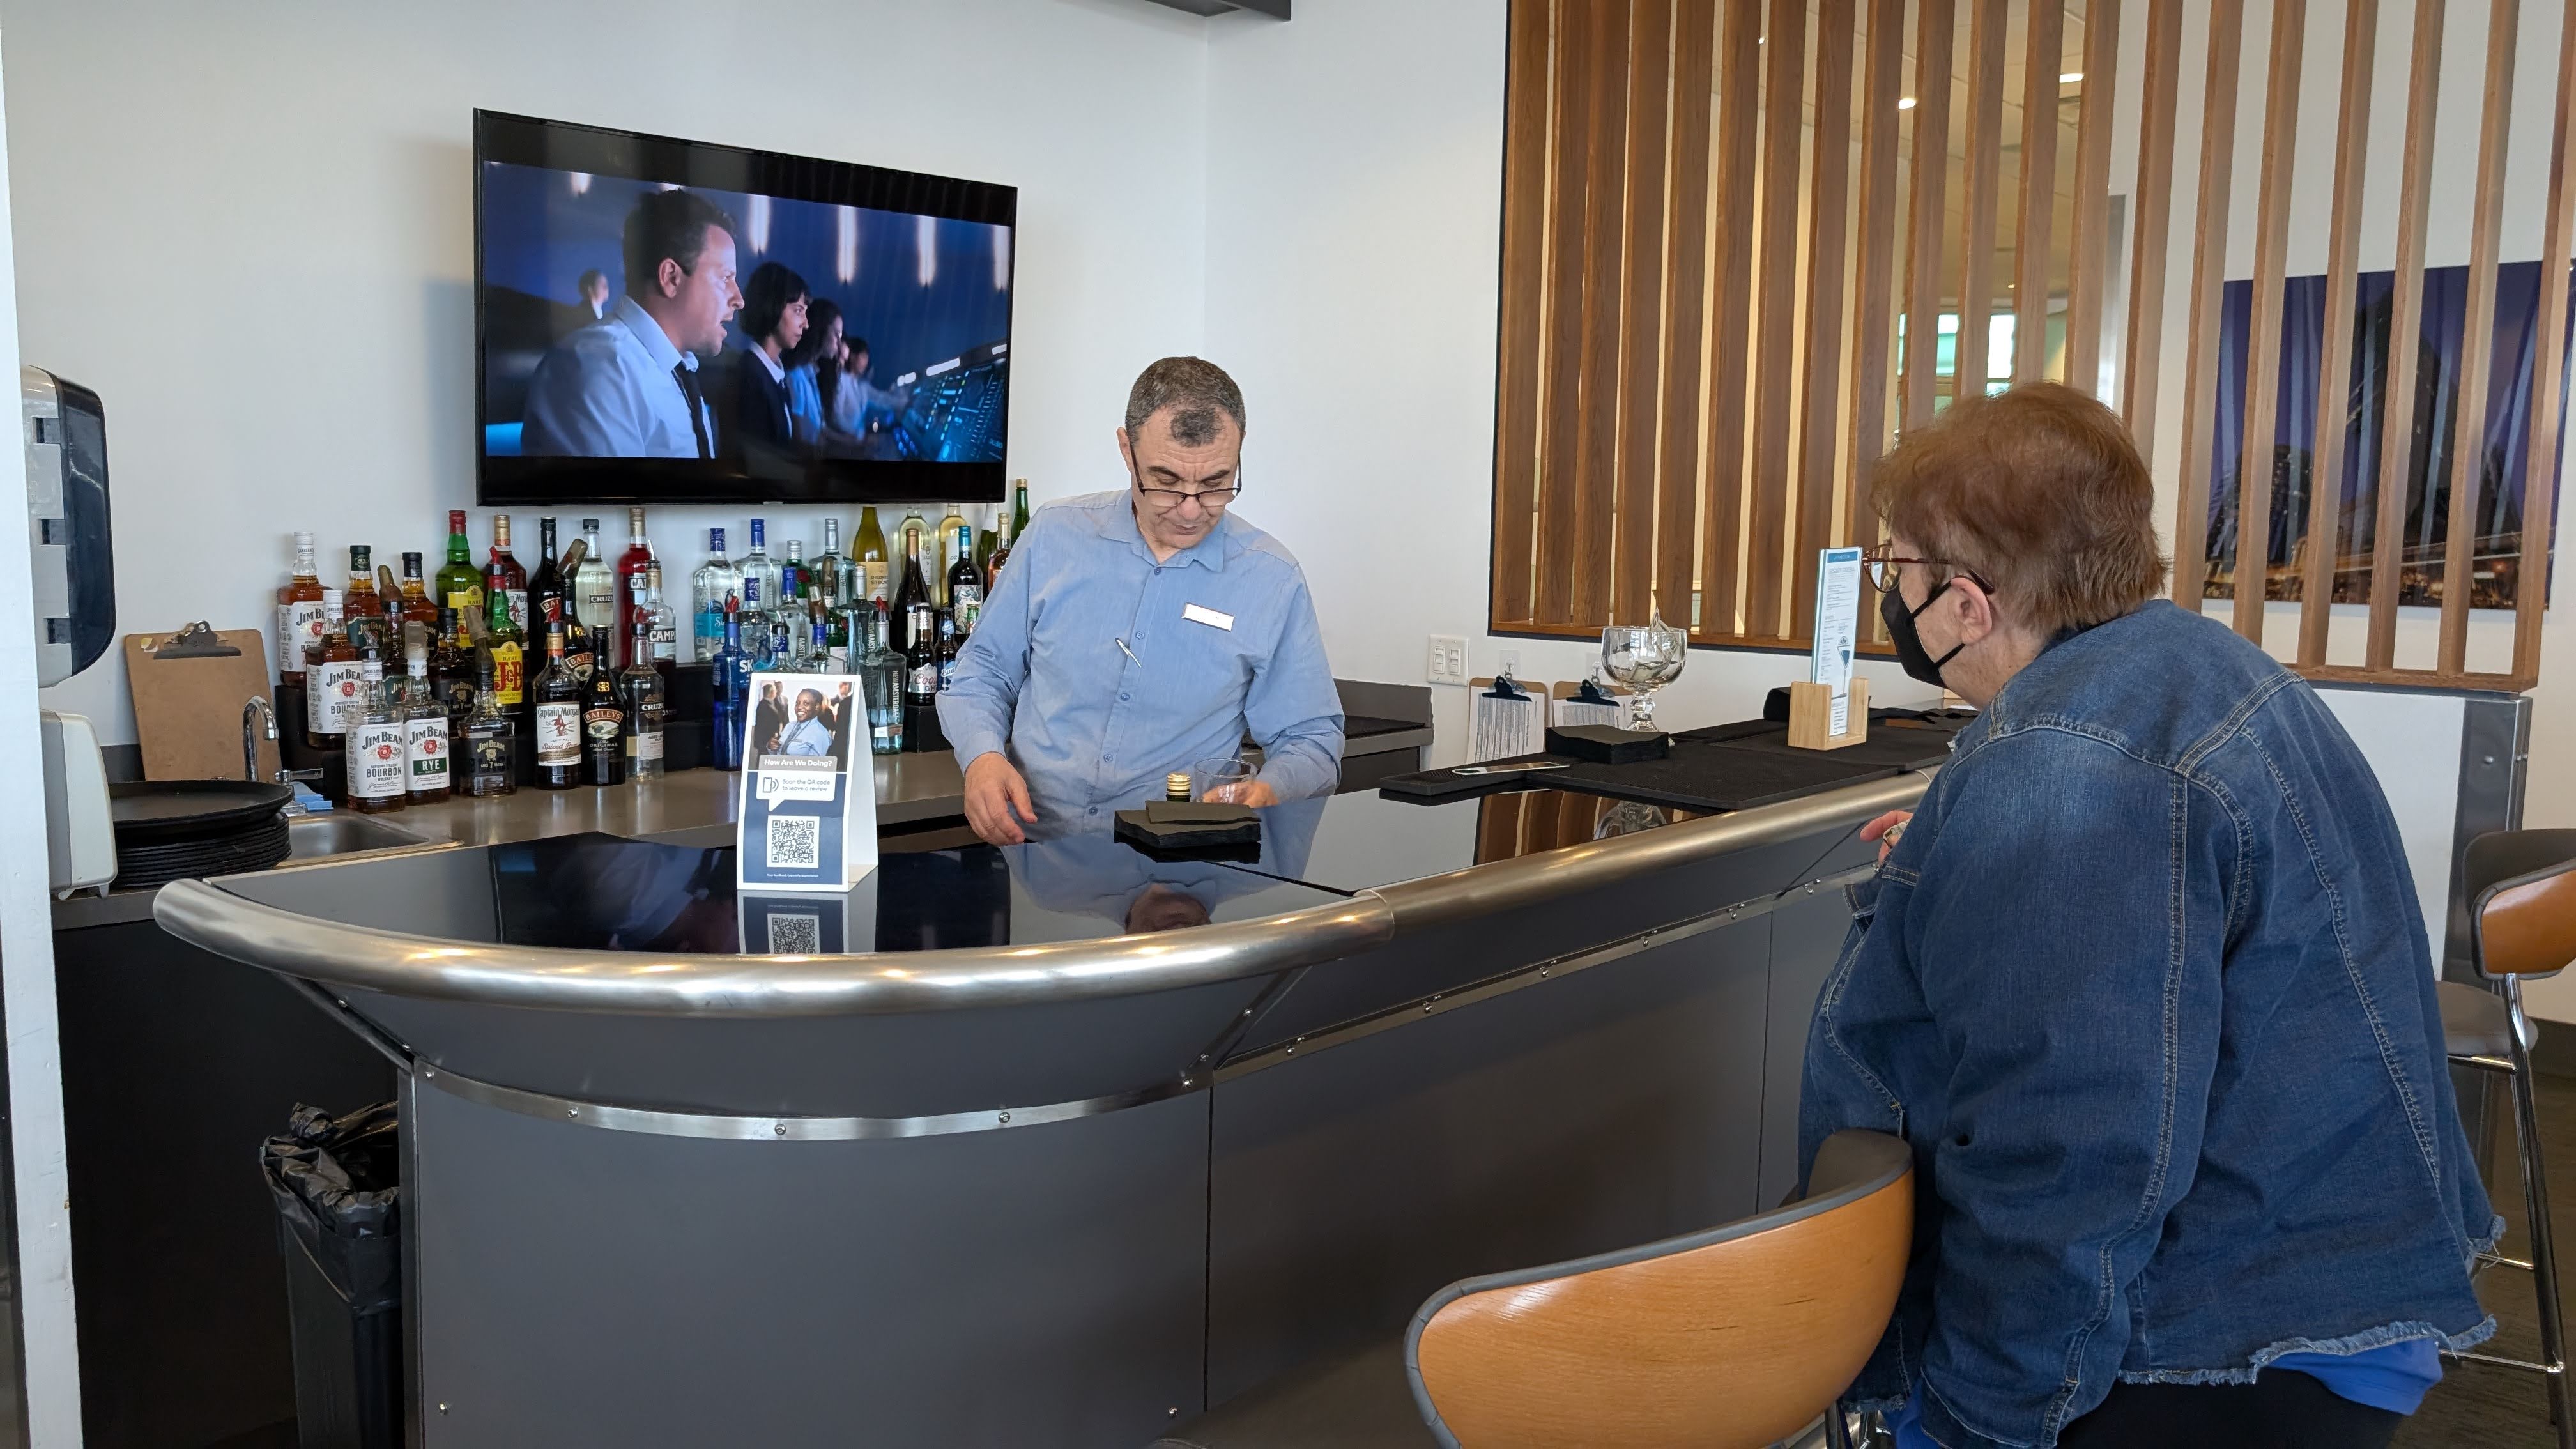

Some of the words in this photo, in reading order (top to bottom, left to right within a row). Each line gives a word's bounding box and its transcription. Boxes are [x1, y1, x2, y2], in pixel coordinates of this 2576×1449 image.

[296, 611, 314, 626] JIM
[649, 630, 675, 641] CAMP
[570, 654, 594, 665] BAILE
[740, 659, 753, 673] SK
[326, 672, 344, 687] JIM
[345, 668, 362, 681] BEA
[641, 703, 663, 711] CRUZ
[538, 707, 560, 719] Captain
[585, 710, 621, 721] BAILEYS
[362, 735, 380, 750] JIM
[381, 731, 403, 747] BEAM
[409, 730, 427, 745] JIM
[427, 726, 448, 741] BEAM
[422, 759, 440, 770] RYE
[366, 767, 402, 778] BOURBON
